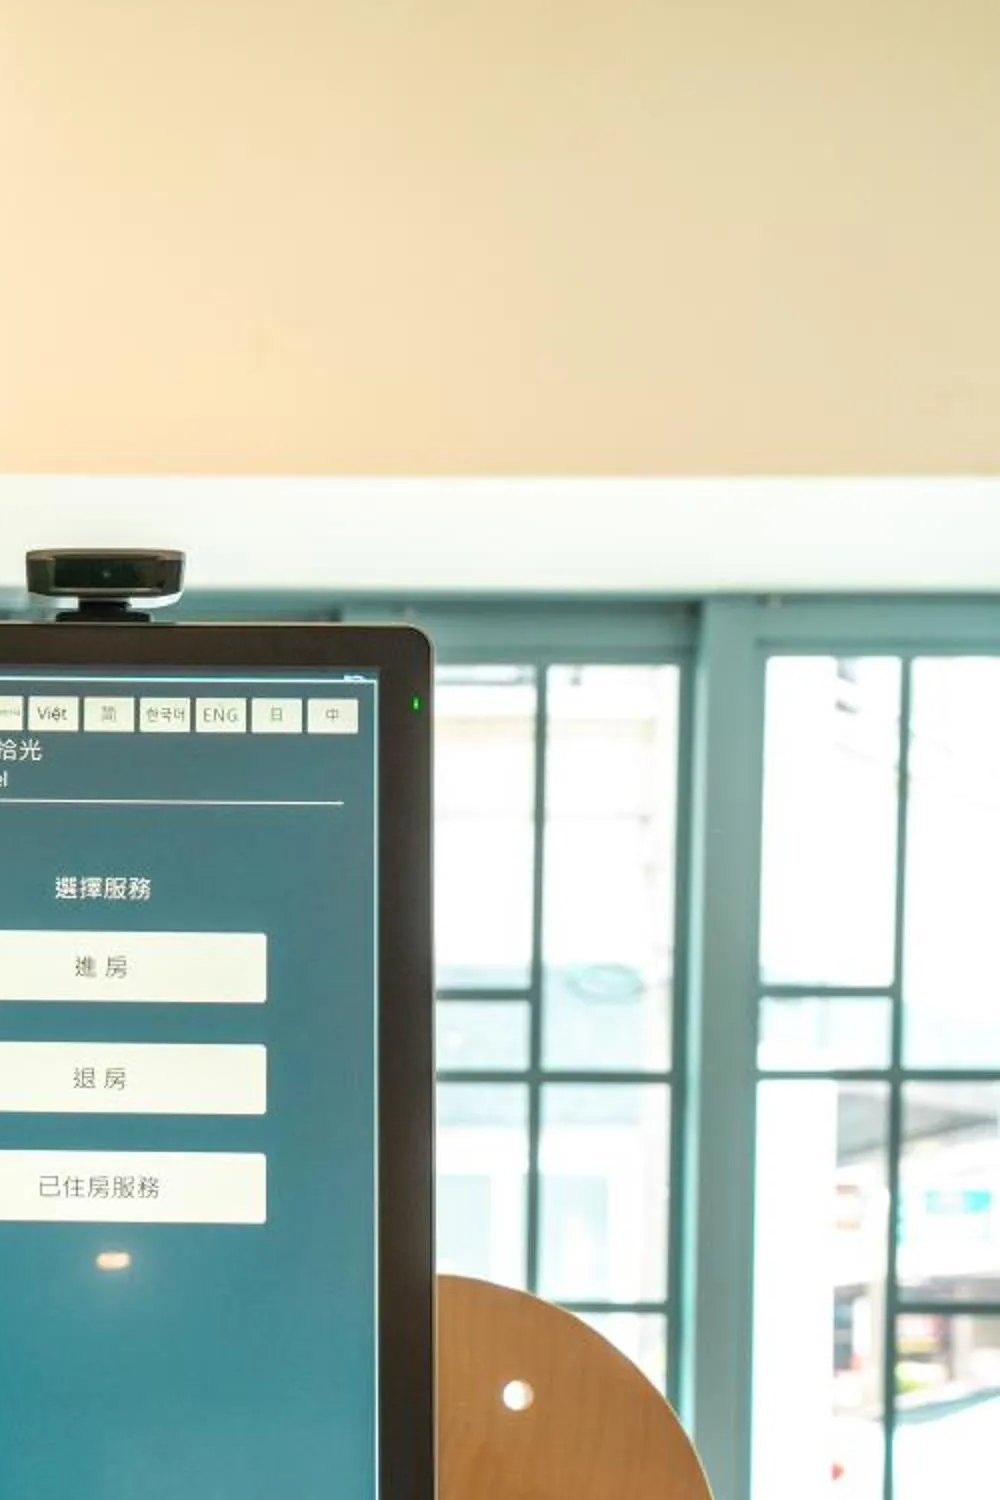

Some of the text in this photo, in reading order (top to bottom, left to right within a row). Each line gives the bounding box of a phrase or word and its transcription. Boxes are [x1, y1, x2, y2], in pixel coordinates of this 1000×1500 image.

[36, 706, 68, 722] Việt
[202, 708, 239, 723] ENG
[271, 707, 284, 722] 日
[326, 707, 340, 721] 中
[55, 876, 152, 900] 選擇服務
[38, 1175, 160, 1200] 已住房服務
